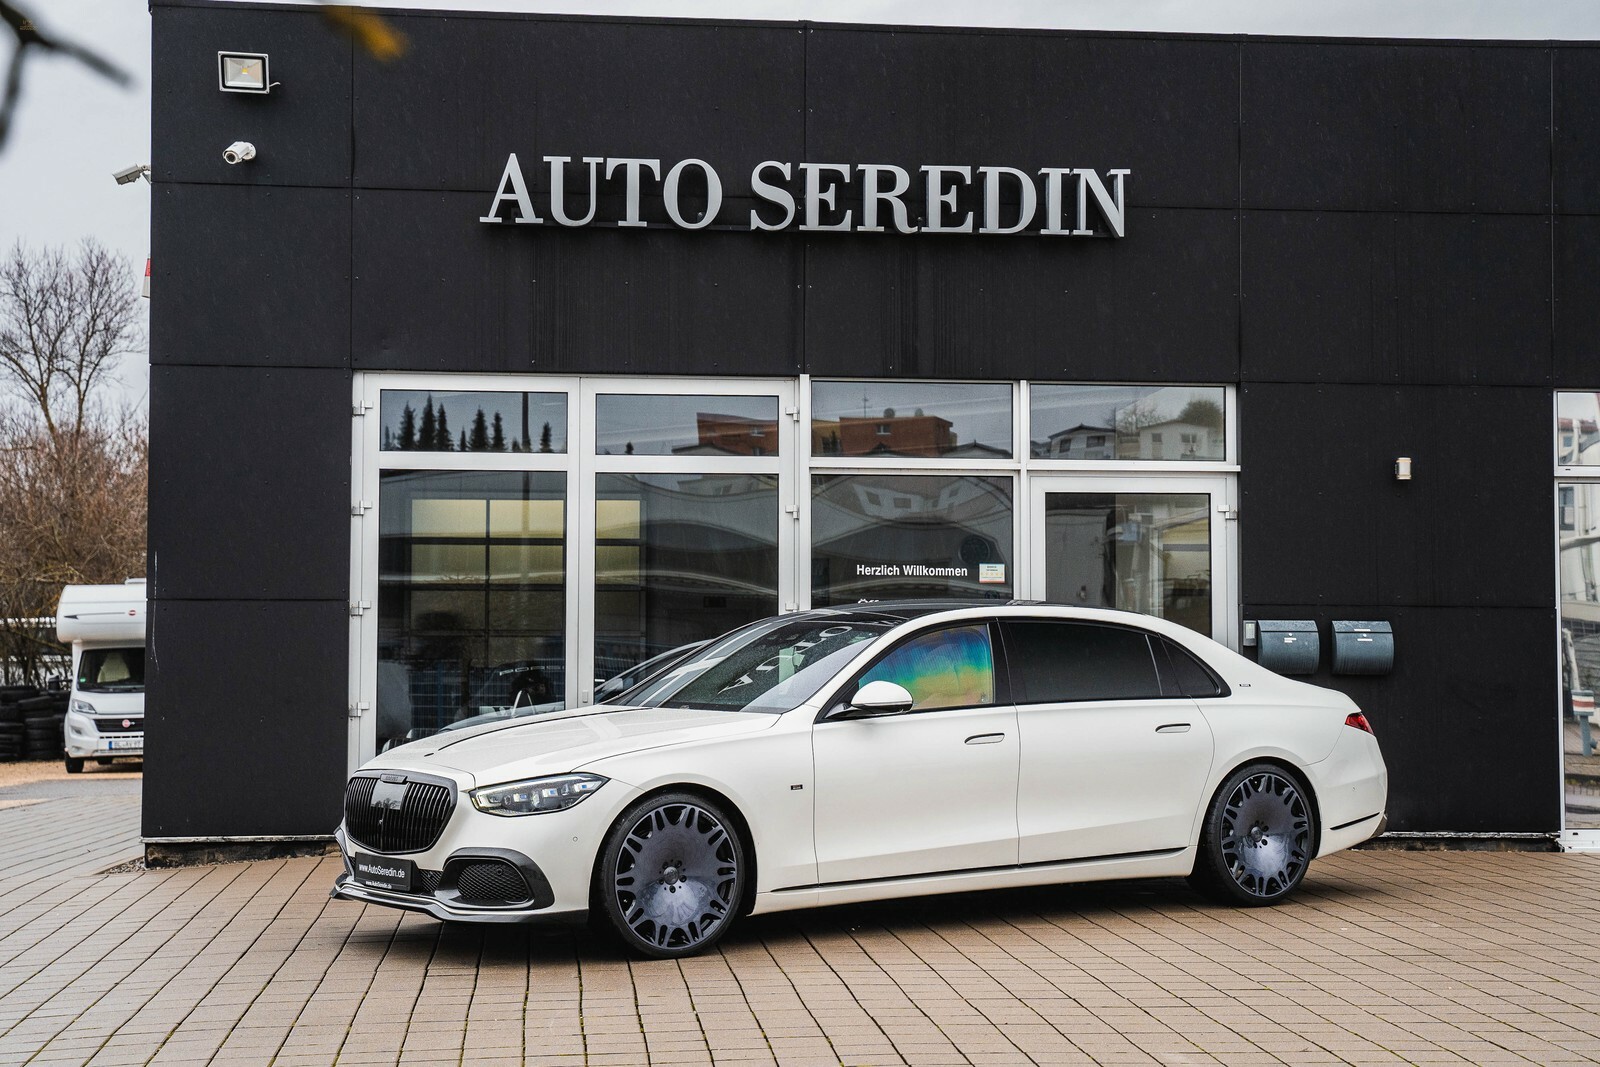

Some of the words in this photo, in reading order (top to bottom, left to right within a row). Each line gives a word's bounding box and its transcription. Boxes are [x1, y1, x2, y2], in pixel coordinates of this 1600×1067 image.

[479, 152, 723, 229] AUTO
[750, 160, 1131, 238] SEREDIN
[856, 564, 900, 576] Herzlich
[902, 564, 968, 577] Willkommen
[358, 864, 405, 878] www.AutoSeredin.de
